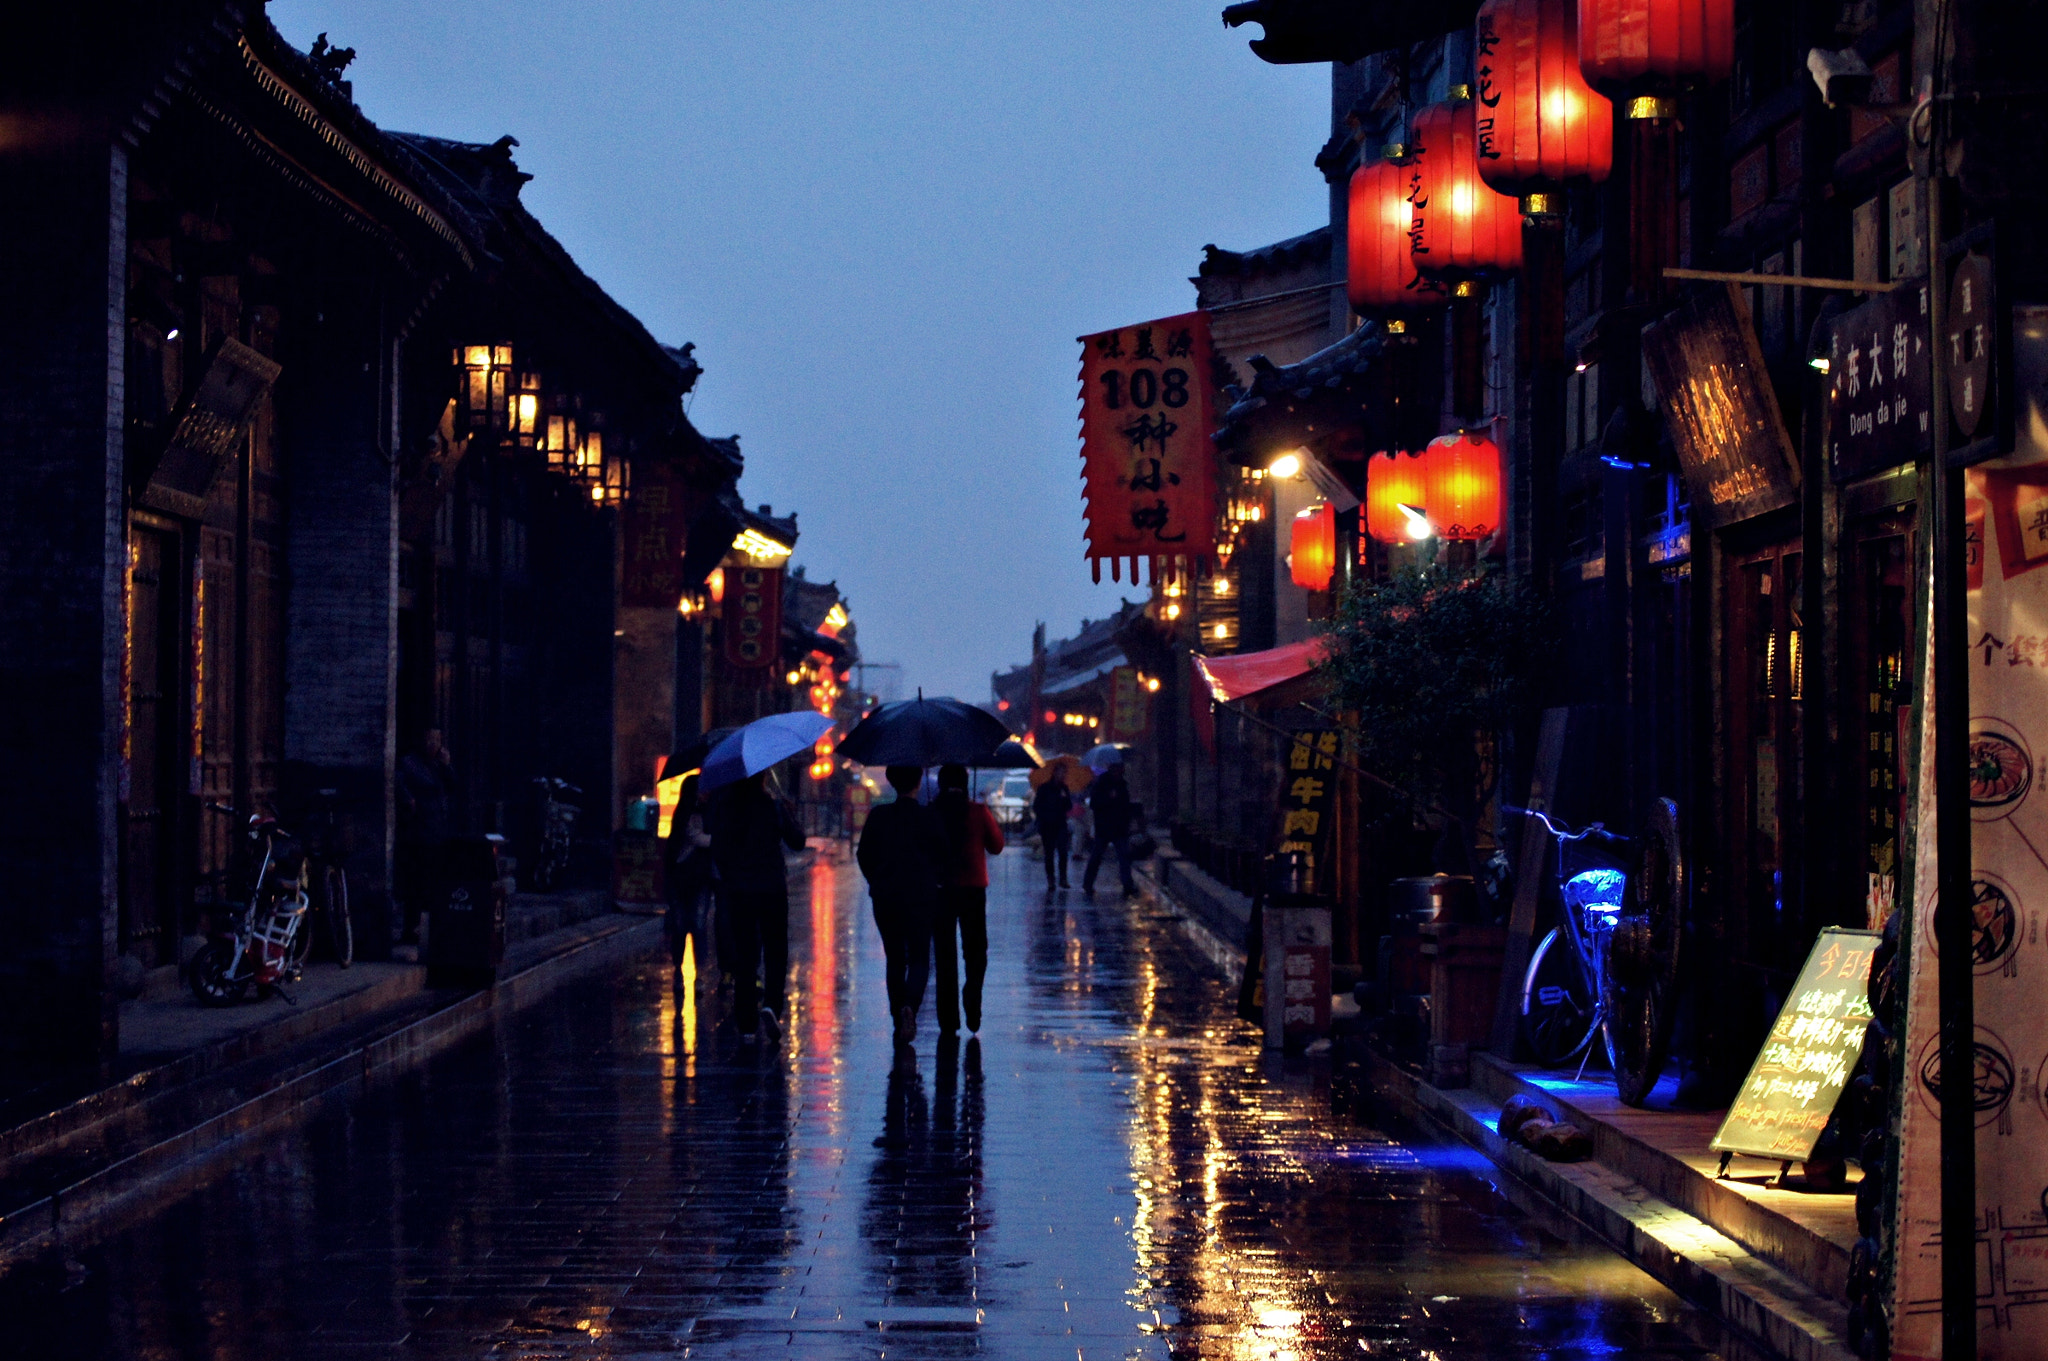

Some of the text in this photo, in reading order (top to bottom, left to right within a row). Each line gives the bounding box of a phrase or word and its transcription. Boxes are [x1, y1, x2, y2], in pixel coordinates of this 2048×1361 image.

[1848, 322, 1908, 399] 东大街
[1100, 367, 1190, 410] 108
[1850, 393, 1908, 437] Dong da jie
[1918, 410, 1928, 433] W
[1833, 442, 1839, 467] E
